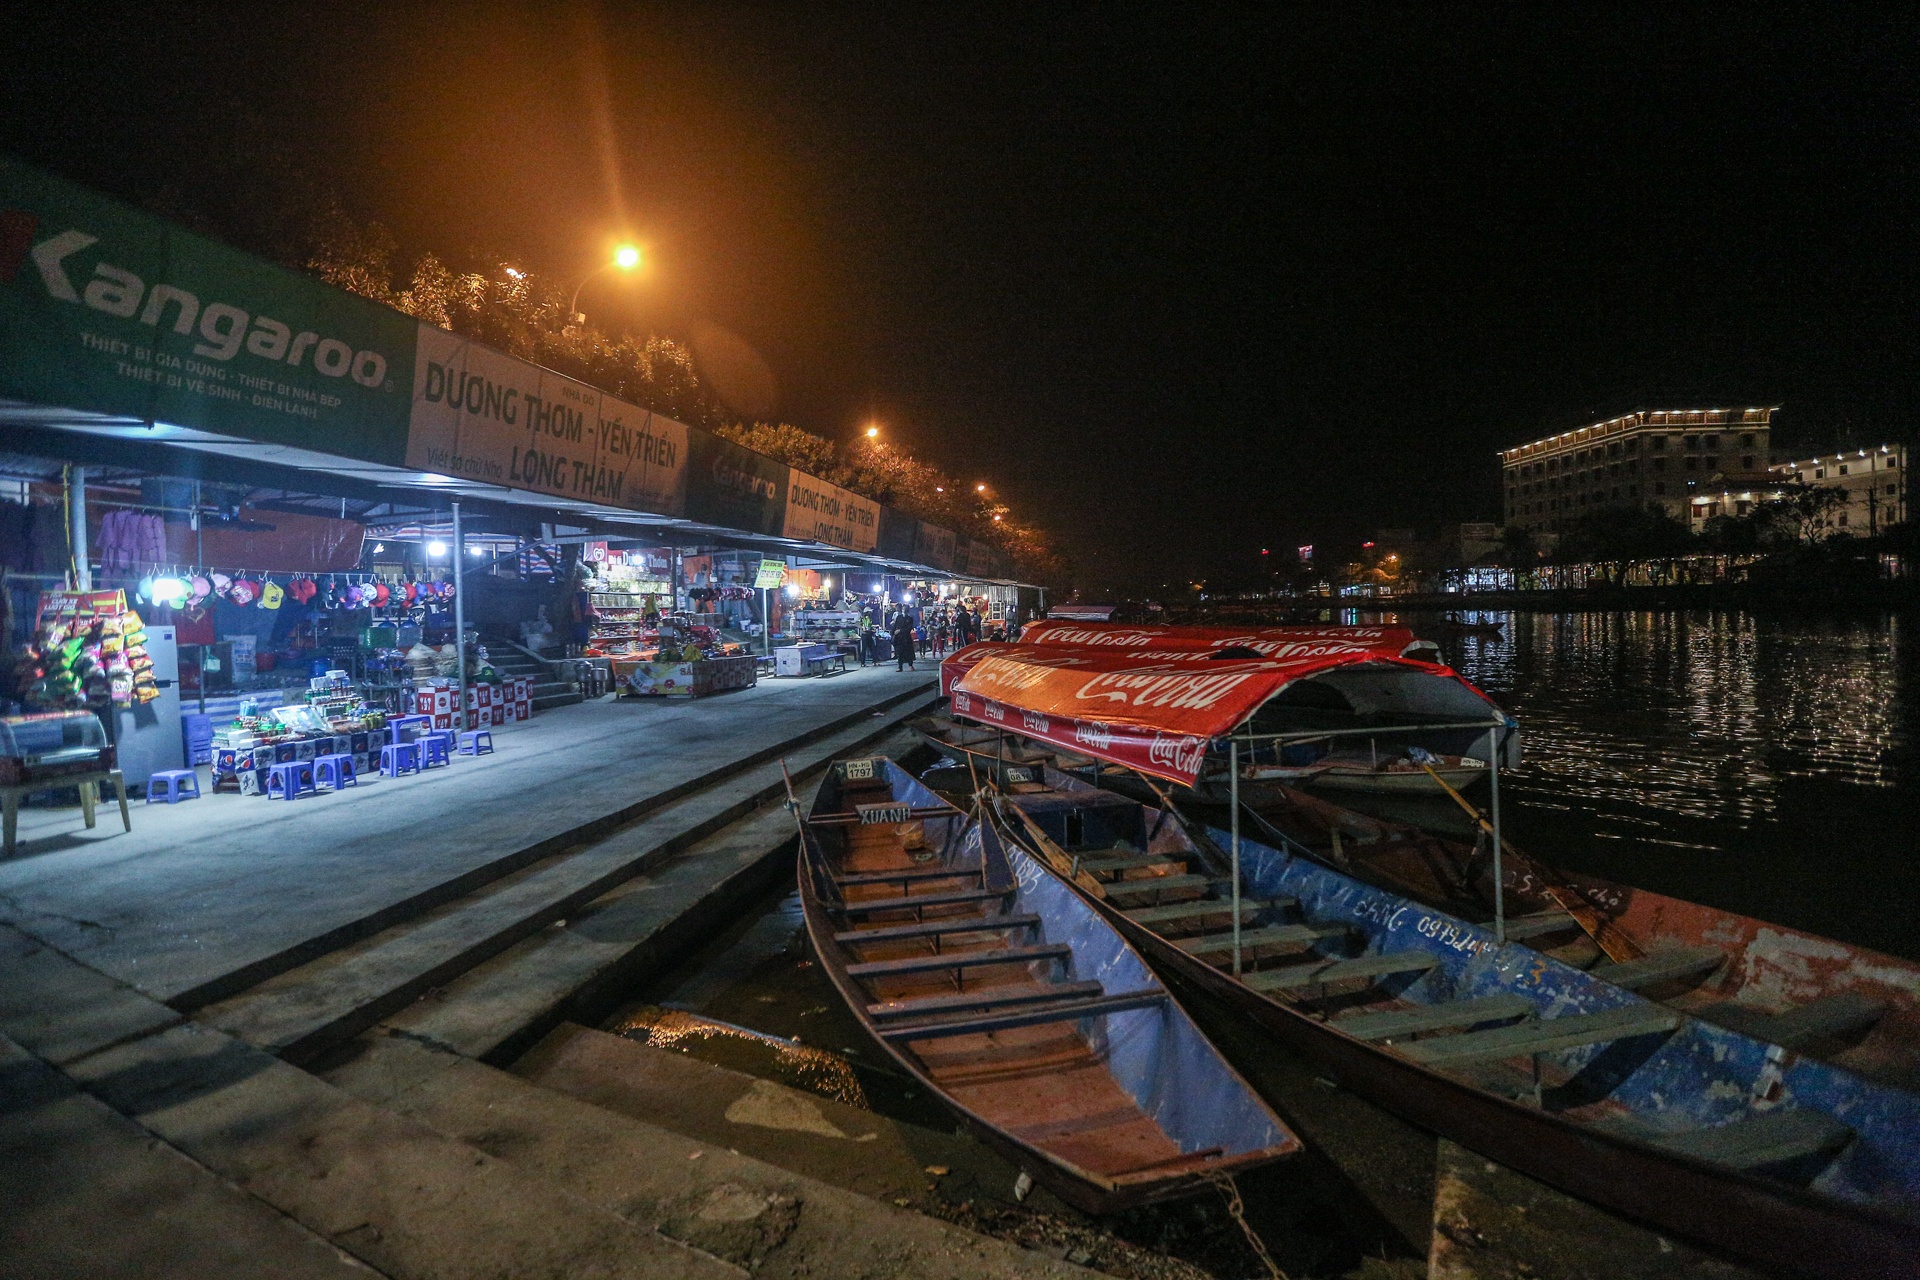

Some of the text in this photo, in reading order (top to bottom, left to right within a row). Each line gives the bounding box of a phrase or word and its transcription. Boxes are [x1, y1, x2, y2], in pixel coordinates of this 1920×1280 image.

[31, 229, 388, 389] Kangaroo
[156, 353, 181, 369] GIA
[208, 384, 241, 401] SINH
[425, 361, 518, 425] DƯƠNG
[509, 445, 567, 490] LONG
[849, 768, 871, 778] 1797
